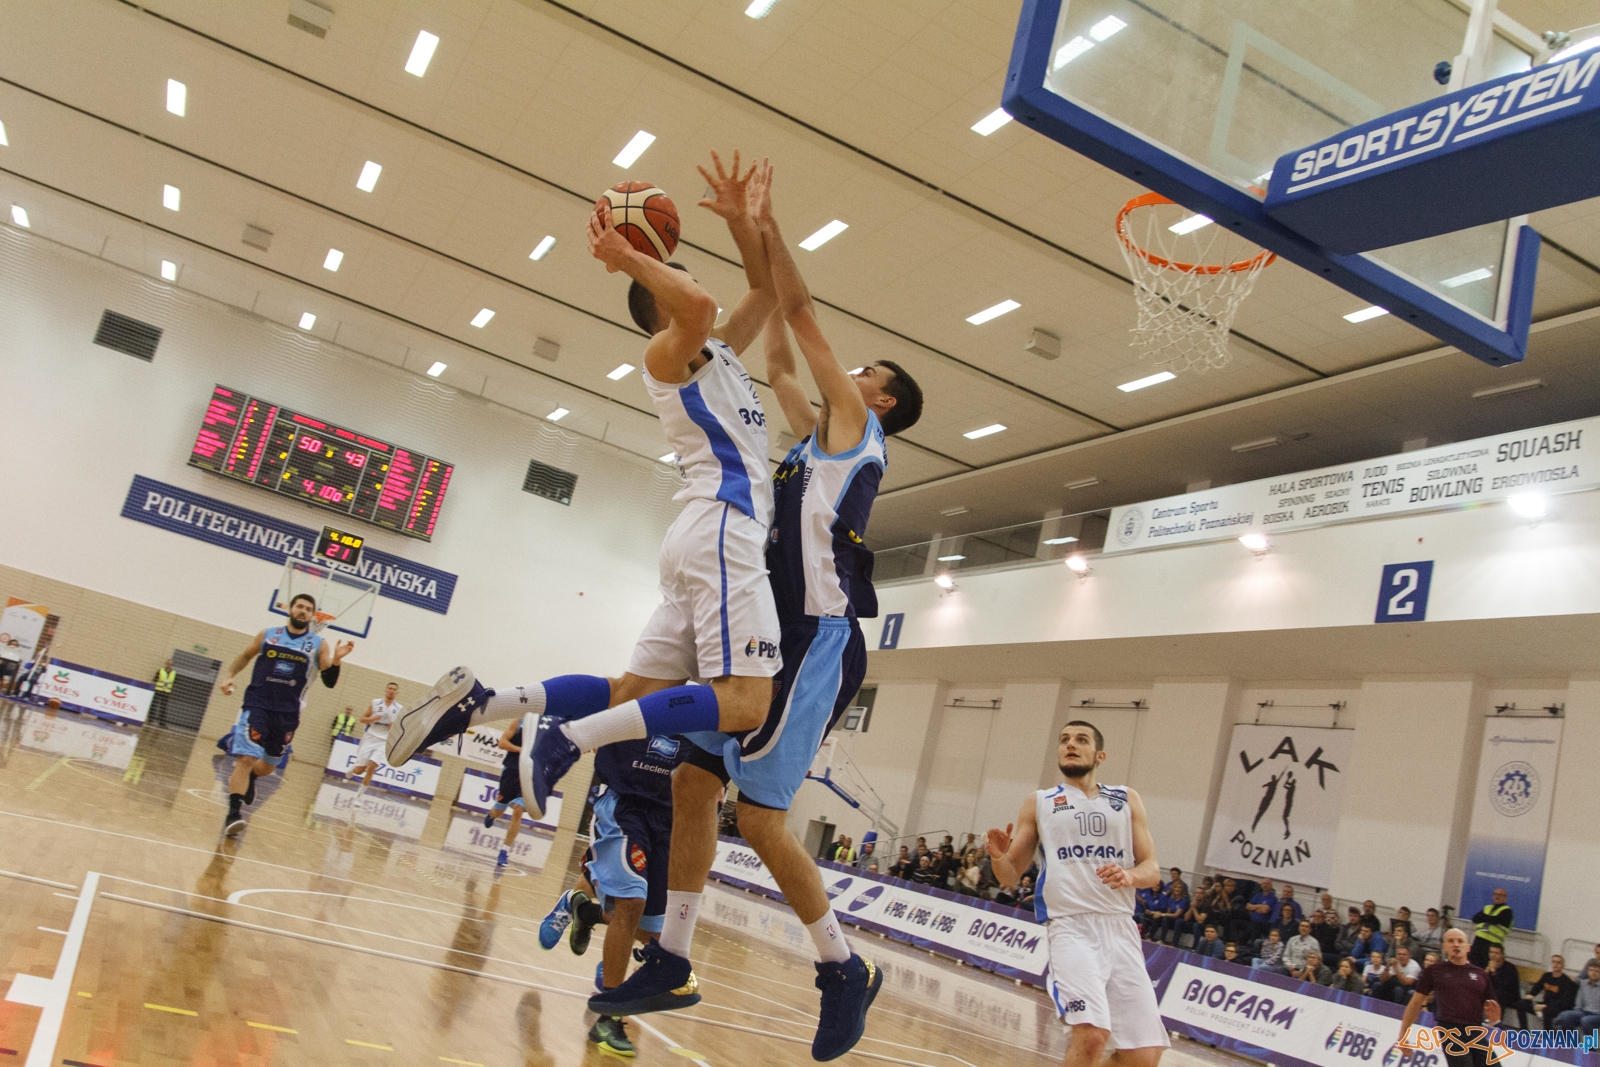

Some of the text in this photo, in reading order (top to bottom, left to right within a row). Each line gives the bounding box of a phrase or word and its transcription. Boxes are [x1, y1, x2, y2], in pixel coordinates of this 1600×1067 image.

[1290, 50, 1600, 182] SPORTSYSTEM
[298, 436, 323, 453] 50
[1496, 429, 1583, 463] SQUASH
[344, 451, 367, 468] 43
[1363, 465, 1388, 479] JUDO
[1268, 470, 1354, 496] HALA SPORTOWA
[1361, 477, 1405, 498] TENIS
[1408, 477, 1484, 503] BOWLING
[1152, 500, 1219, 520] Centrum Sportu
[1303, 501, 1350, 519] AEROBIK
[142, 491, 304, 558] POLITECHNIKA
[325, 543, 351, 560] 21
[1387, 568, 1419, 615] 2
[884, 617, 896, 646] 1
[93, 695, 138, 713] CYMES
[1240, 736, 1341, 791] LAK
[1074, 811, 1107, 837] 10
[1230, 829, 1311, 868] POZNAŃ
[967, 918, 1041, 953] BIOFARM
[1182, 978, 1299, 1030] BIOFARM
[1185, 1005, 1209, 1020] POLSKI
[1210, 1013, 1251, 1031] PRODUCENT
[1337, 1030, 1378, 1061] PBG
